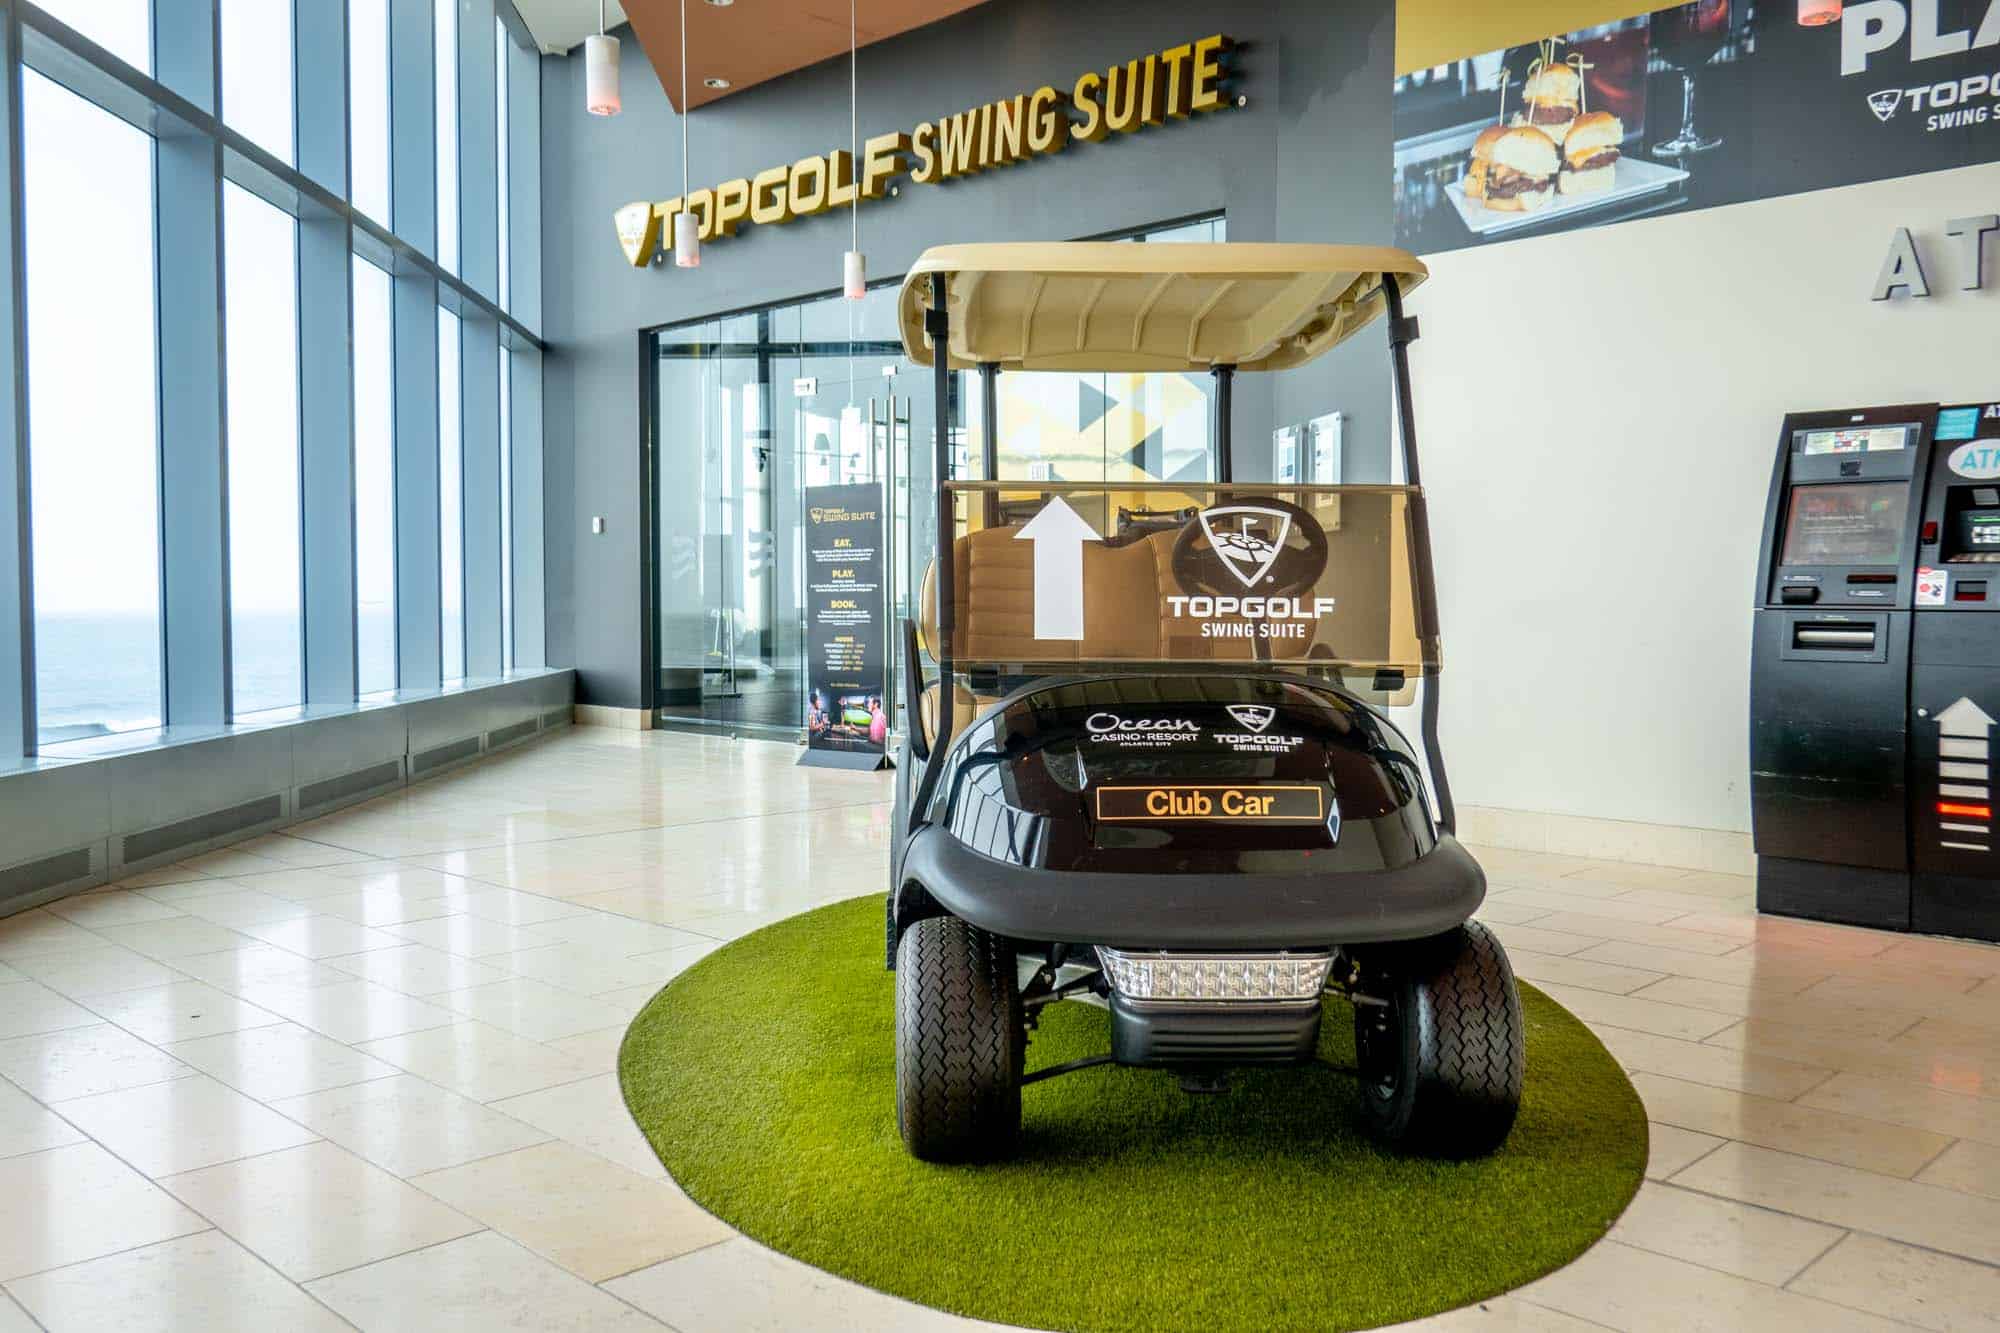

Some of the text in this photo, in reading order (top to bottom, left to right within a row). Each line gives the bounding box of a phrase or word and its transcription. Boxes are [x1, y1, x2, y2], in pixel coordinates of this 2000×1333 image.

[910, 86, 1057, 184] SWING
[1070, 33, 1223, 140] SUITE
[1926, 106, 1987, 132] SWING
[831, 569, 855, 578] PLAY.
[830, 600, 857, 609] BOOK.
[1167, 596, 1335, 619] TOPGOLF
[1201, 623, 1306, 638] SWING SUITE
[1085, 712, 1202, 733] Ocean
[1146, 732, 1199, 742] RESORT
[1213, 734, 1304, 746] TOPGOLF
[1146, 790, 1275, 816] Club Car
